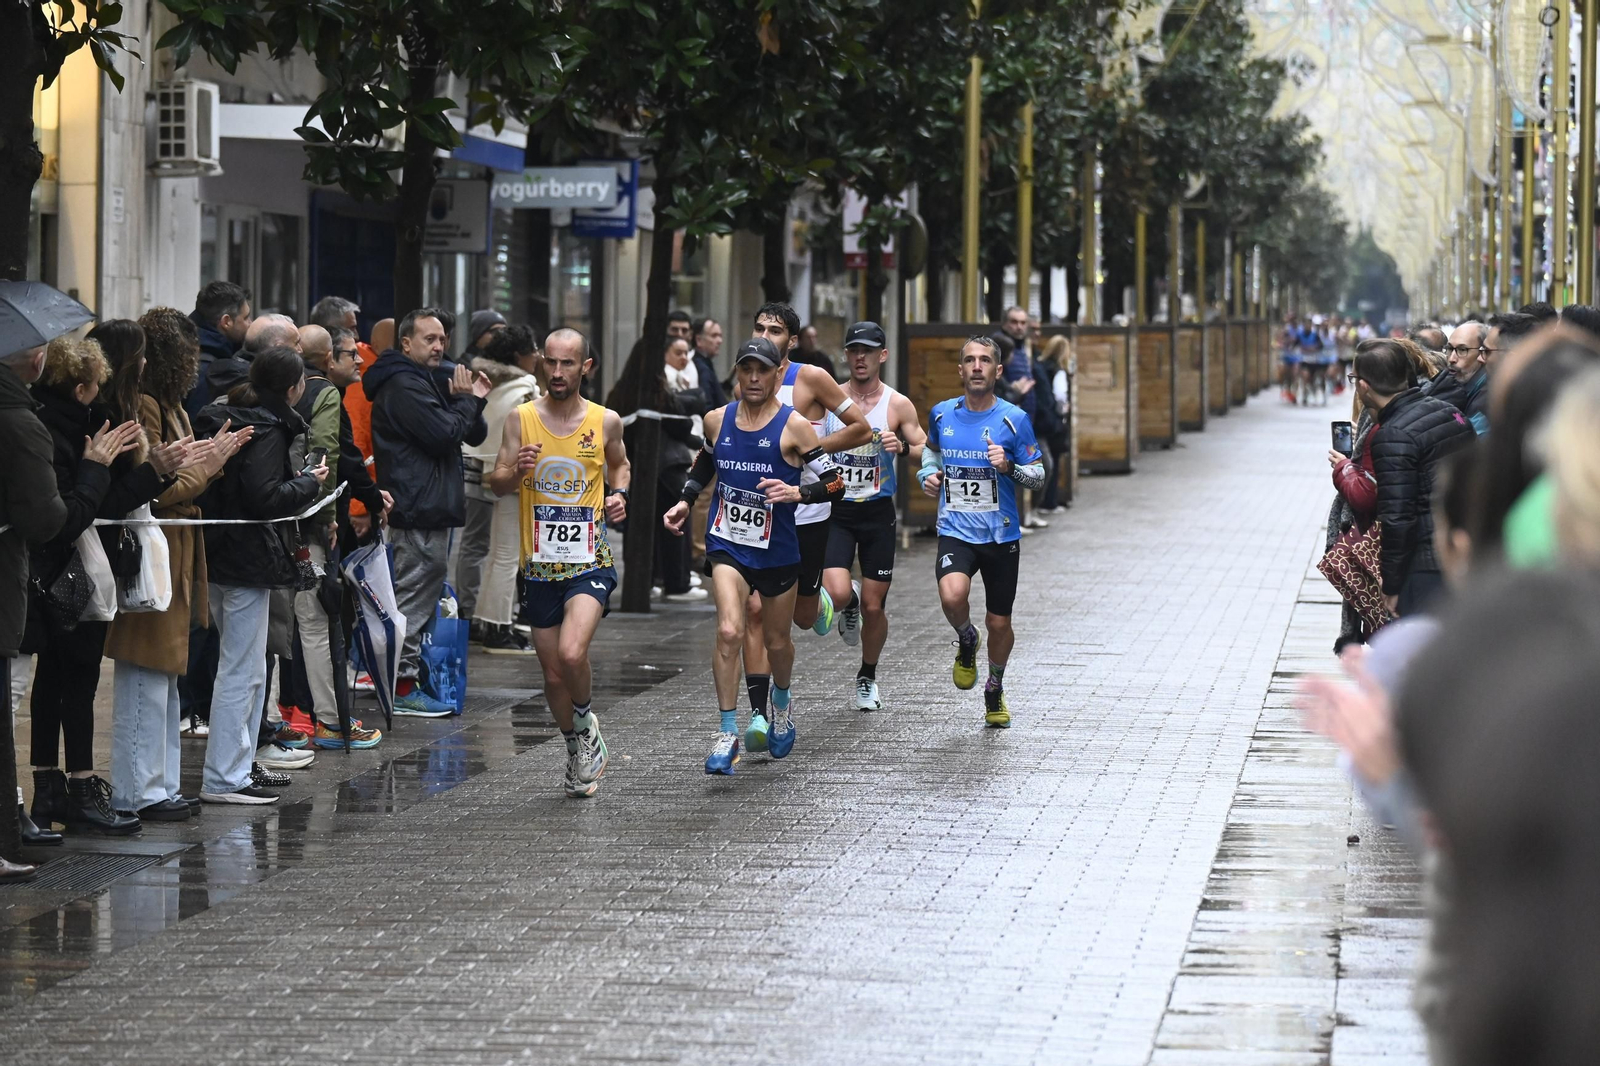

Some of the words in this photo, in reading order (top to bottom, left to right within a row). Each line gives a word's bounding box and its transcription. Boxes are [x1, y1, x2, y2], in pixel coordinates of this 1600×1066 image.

[941, 448, 989, 460] TROTASIERR
[717, 459, 773, 473] TROTASIERRA
[960, 481, 981, 496] 12
[724, 503, 765, 528] 1946
[545, 524, 582, 542] 782
